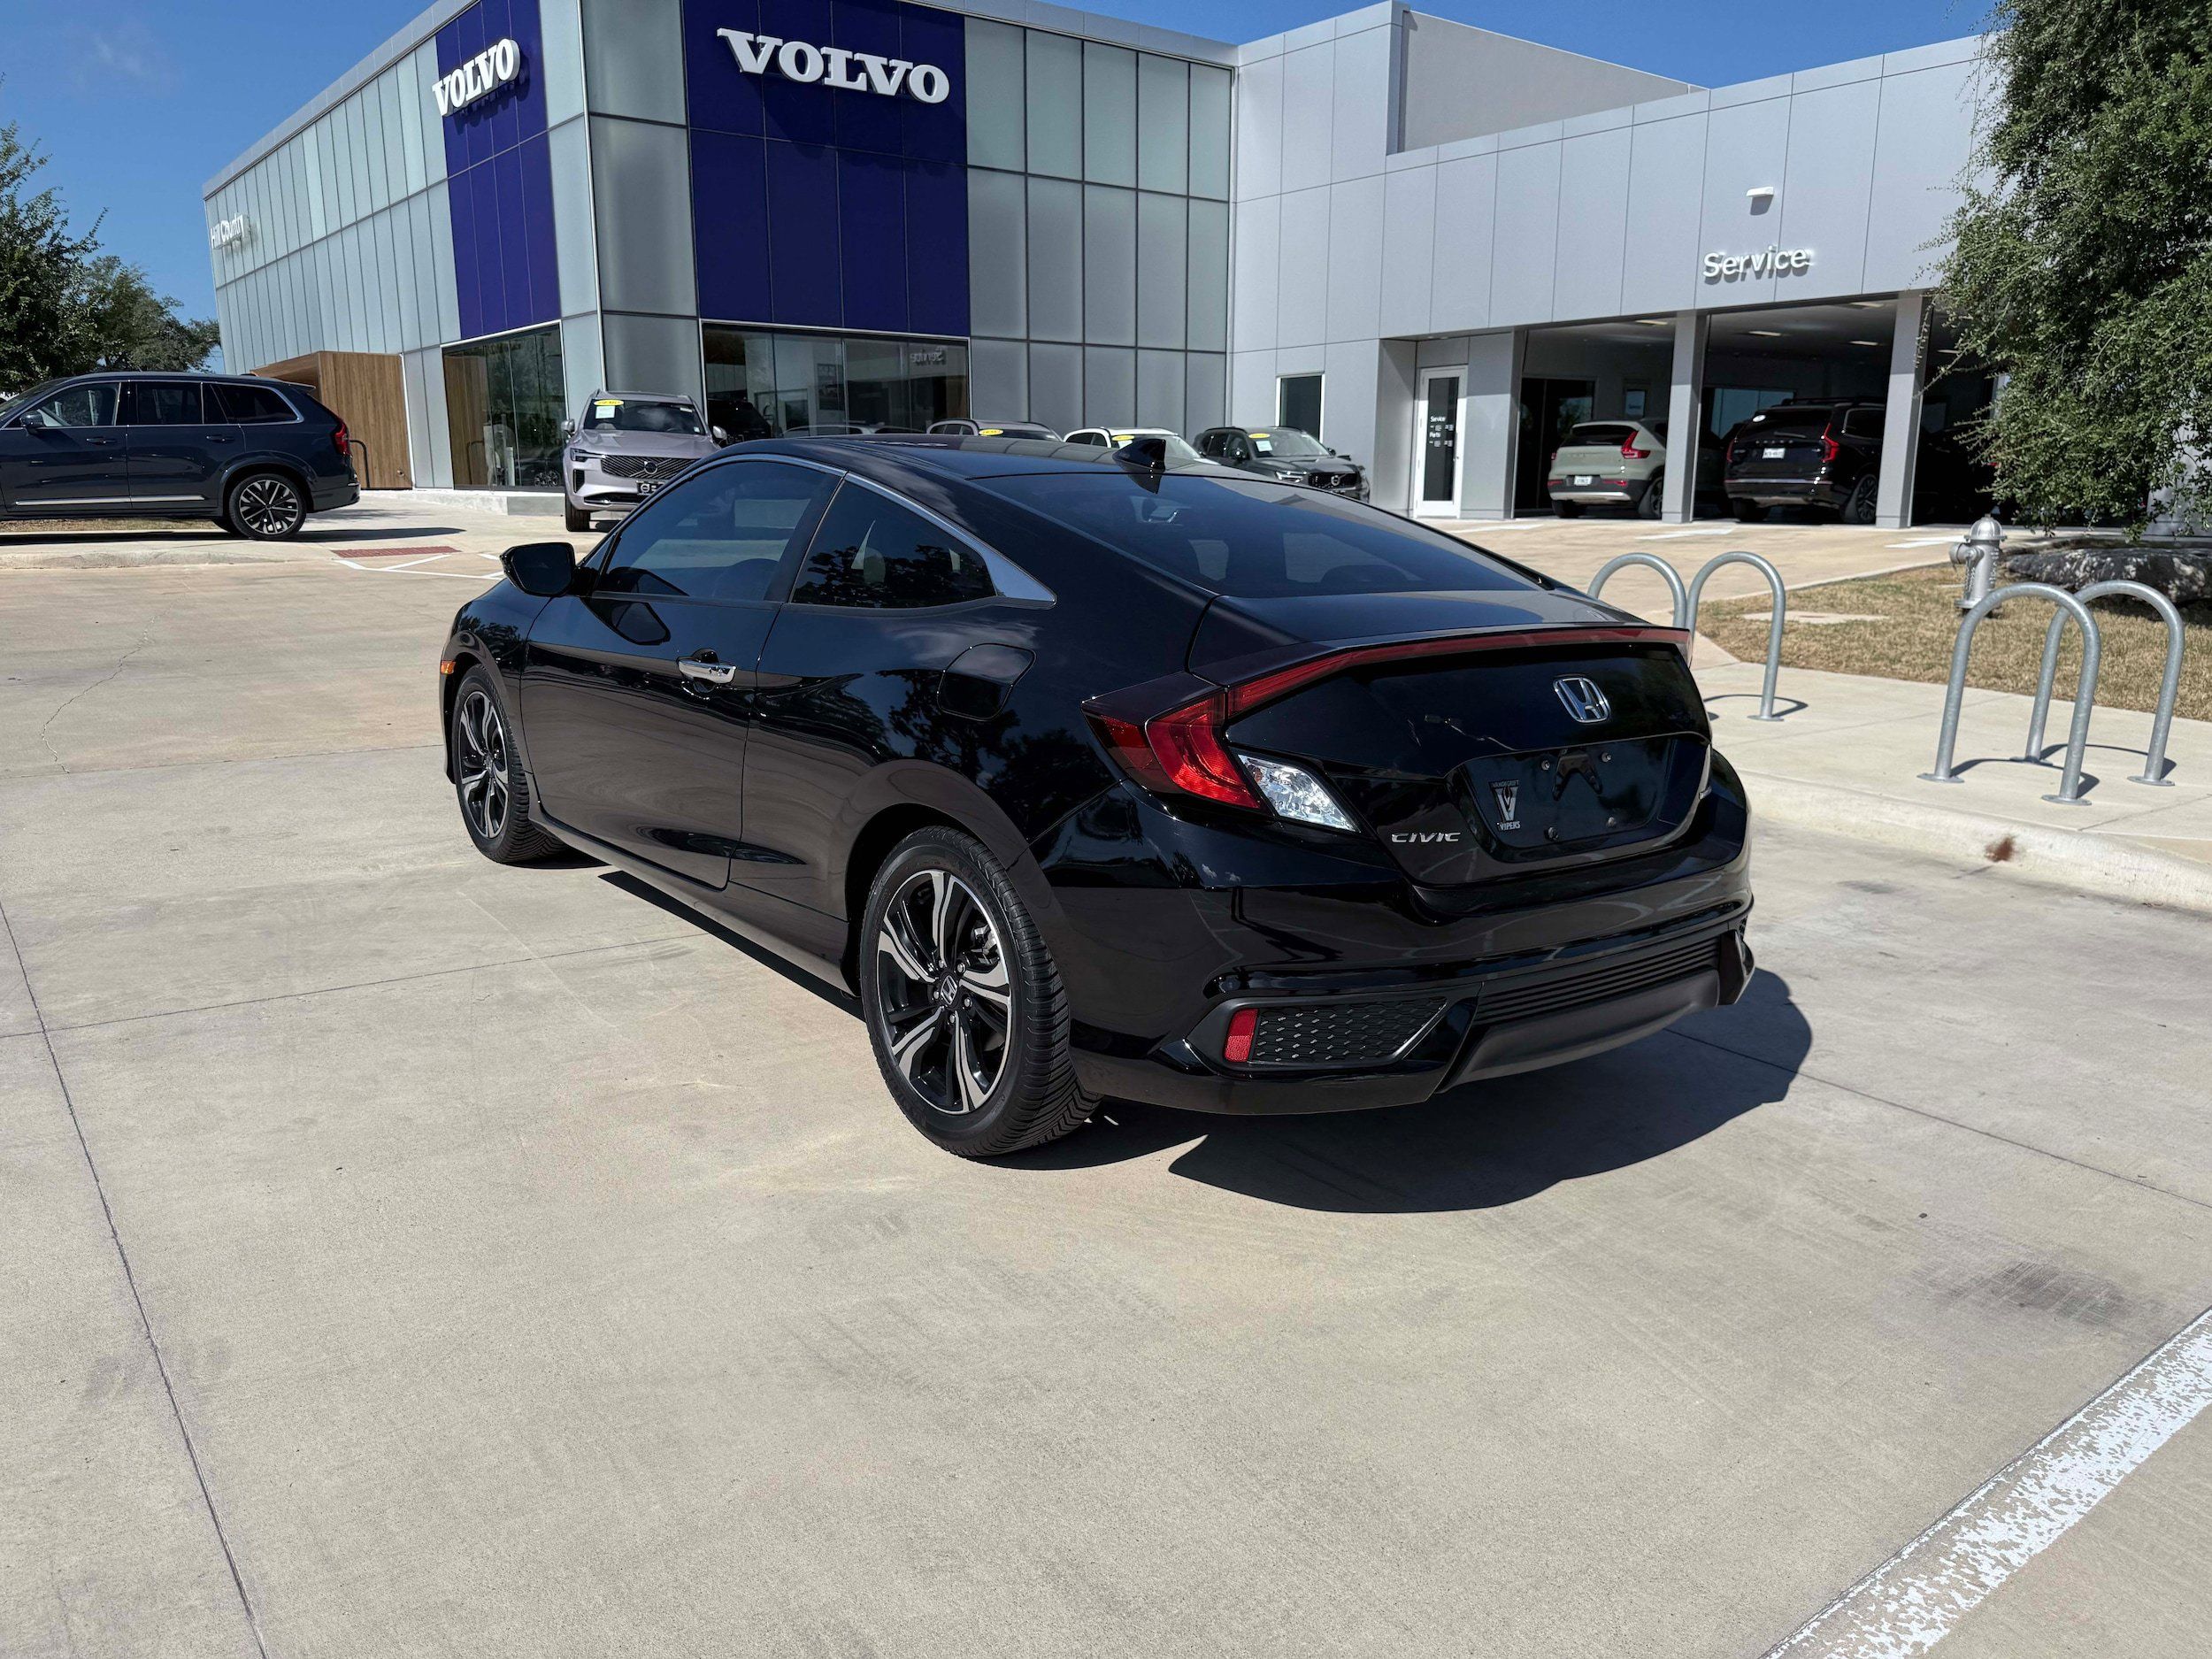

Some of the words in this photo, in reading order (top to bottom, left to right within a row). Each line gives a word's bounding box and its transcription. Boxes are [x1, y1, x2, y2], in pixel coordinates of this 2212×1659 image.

[432, 38, 520, 117] VOLVO
[717, 27, 950, 104] VOLVO
[1702, 245, 1810, 278] Service
[1391, 832, 1461, 843] CIVIC
[1499, 821, 1521, 831] VIPERS
